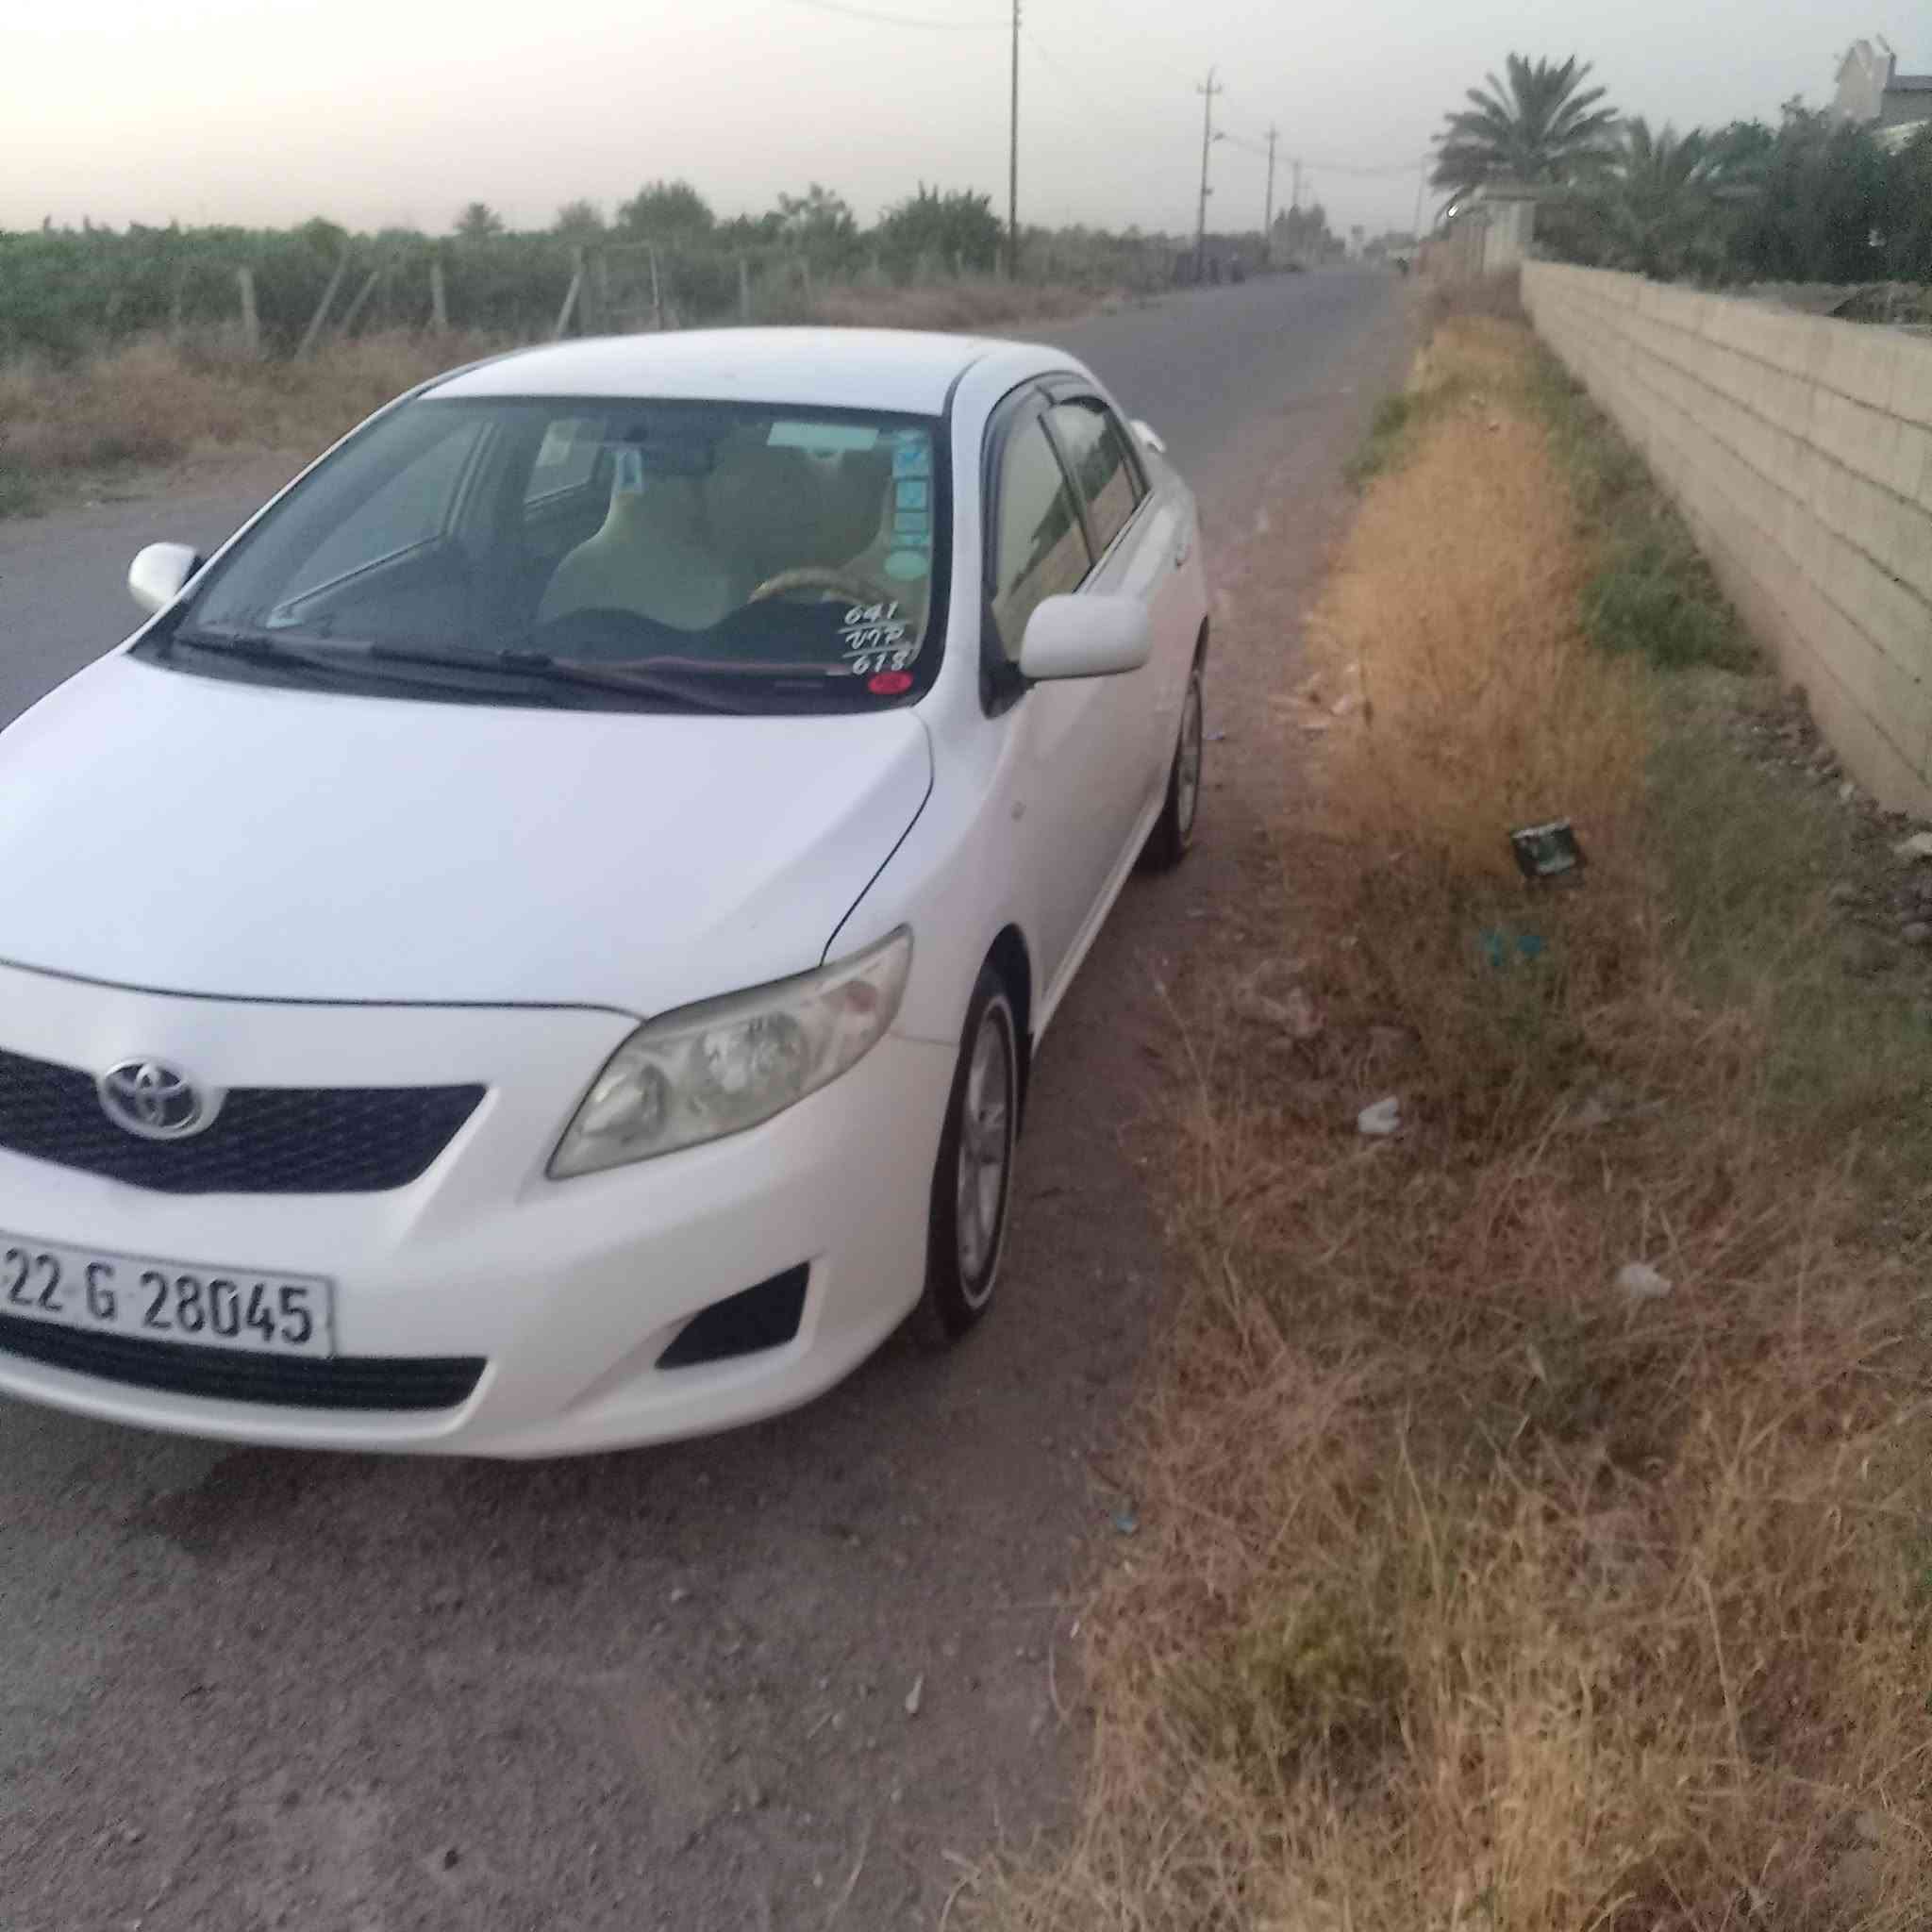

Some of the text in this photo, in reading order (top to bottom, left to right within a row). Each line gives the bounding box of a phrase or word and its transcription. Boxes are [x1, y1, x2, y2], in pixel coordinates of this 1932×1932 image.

[6, 1247, 312, 1344] 22 G 28045
